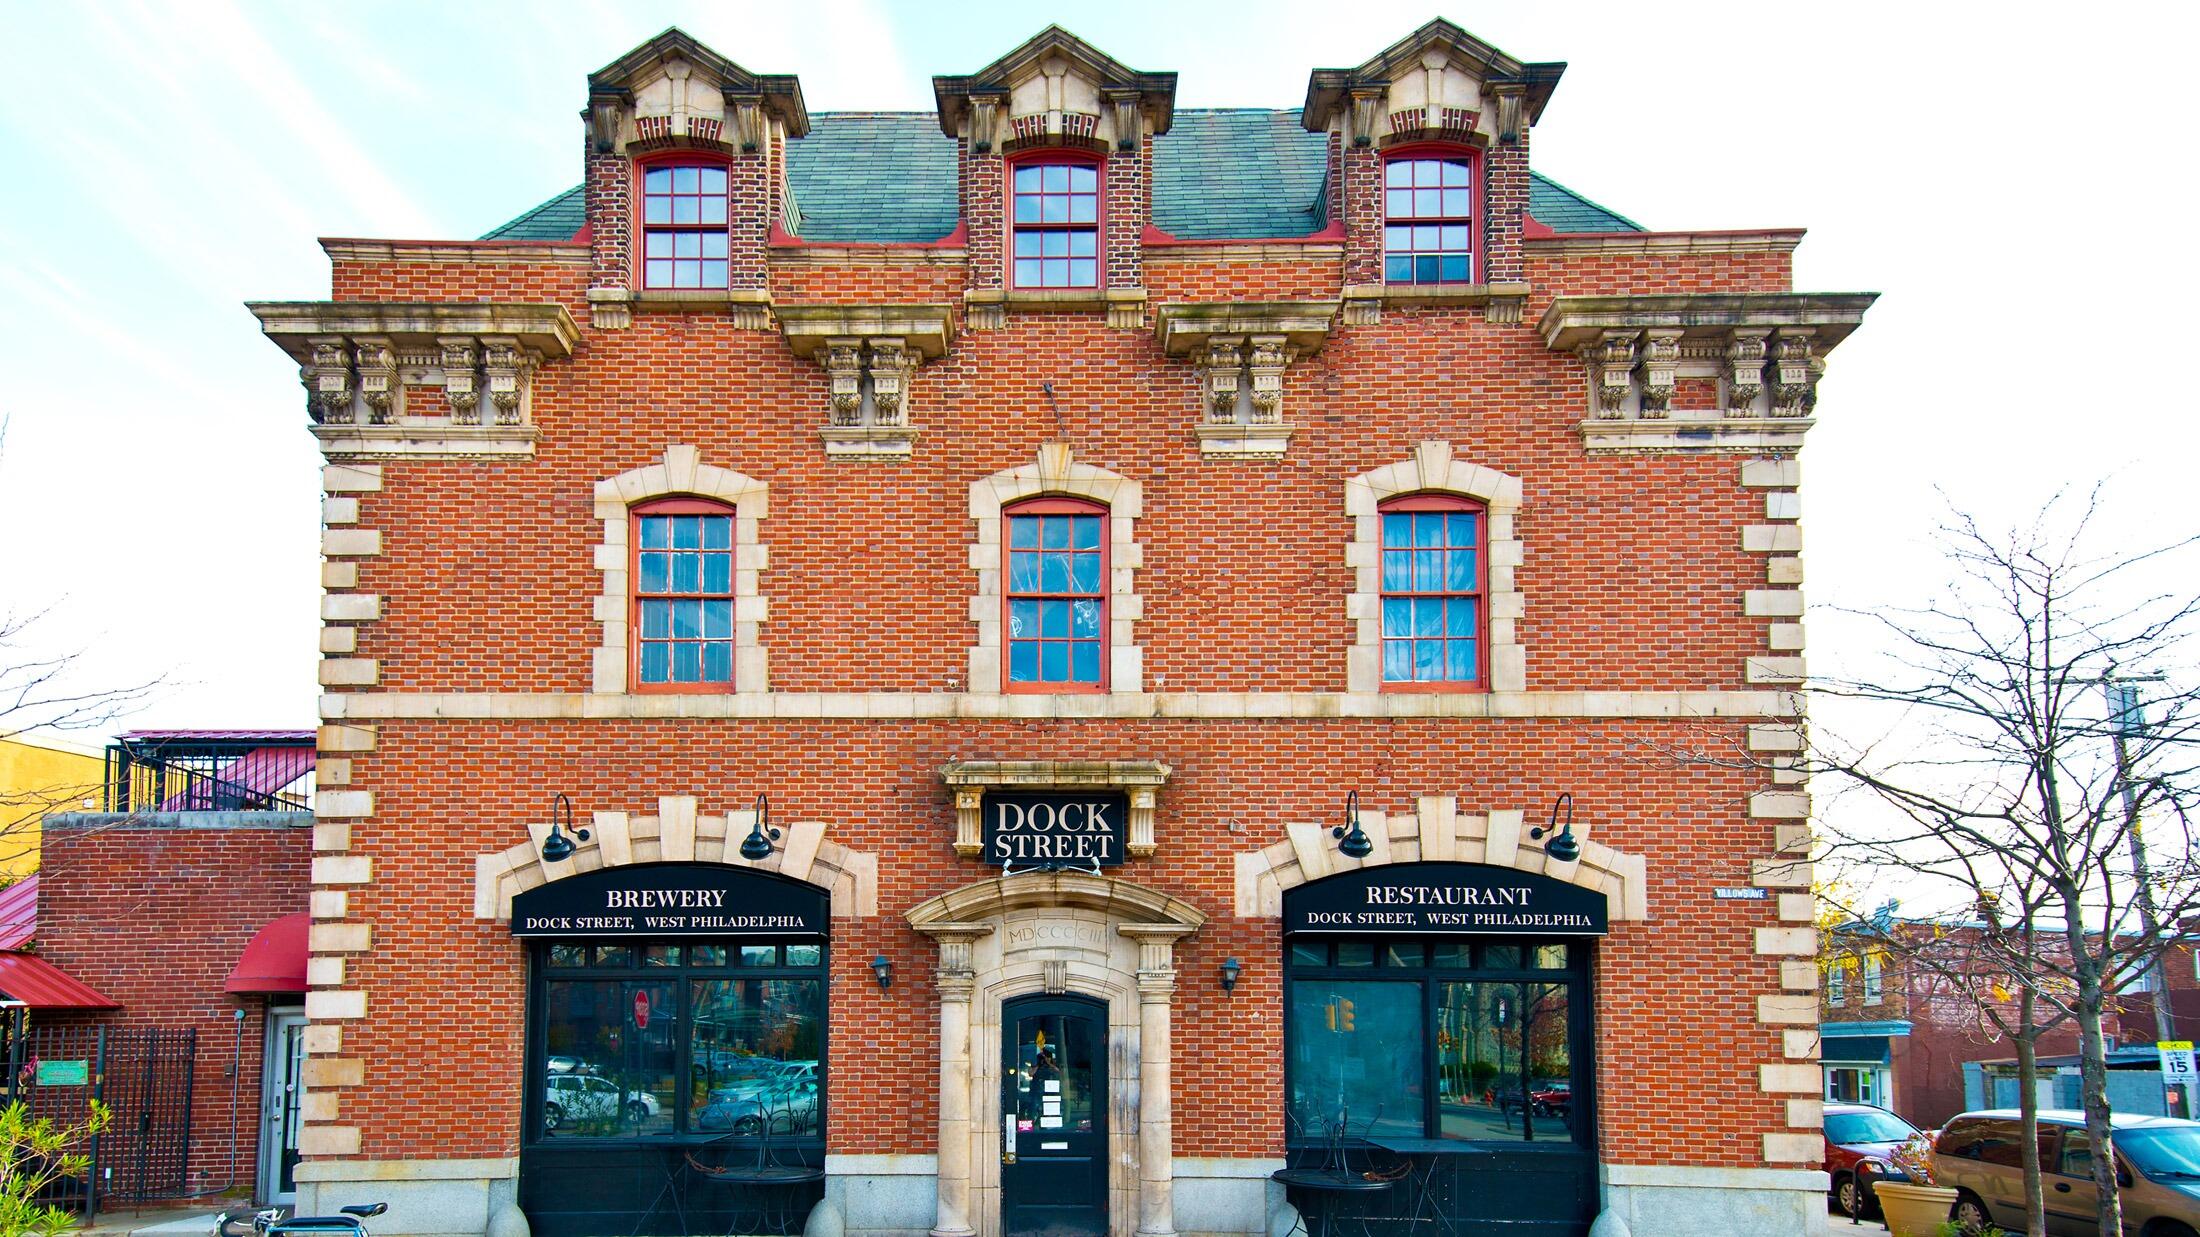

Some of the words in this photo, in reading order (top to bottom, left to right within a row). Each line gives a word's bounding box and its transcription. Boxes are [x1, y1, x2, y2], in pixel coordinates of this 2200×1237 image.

[996, 803, 1112, 832] DOCK
[995, 834, 1114, 858] STREET
[606, 889, 727, 908] BREWERY
[1366, 886, 1532, 905] RESTAURANT
[526, 917, 571, 929] DOCK
[575, 916, 635, 930] STREET,
[645, 916, 686, 928] WEST
[691, 915, 804, 927] PHILADELPHIA
[1307, 912, 1353, 924] DOCK
[1357, 912, 1417, 926] STREET,
[1427, 913, 1469, 925] WEST
[1474, 913, 1592, 926] PHILADELPHIA
[2169, 1061, 2189, 1073] 15
